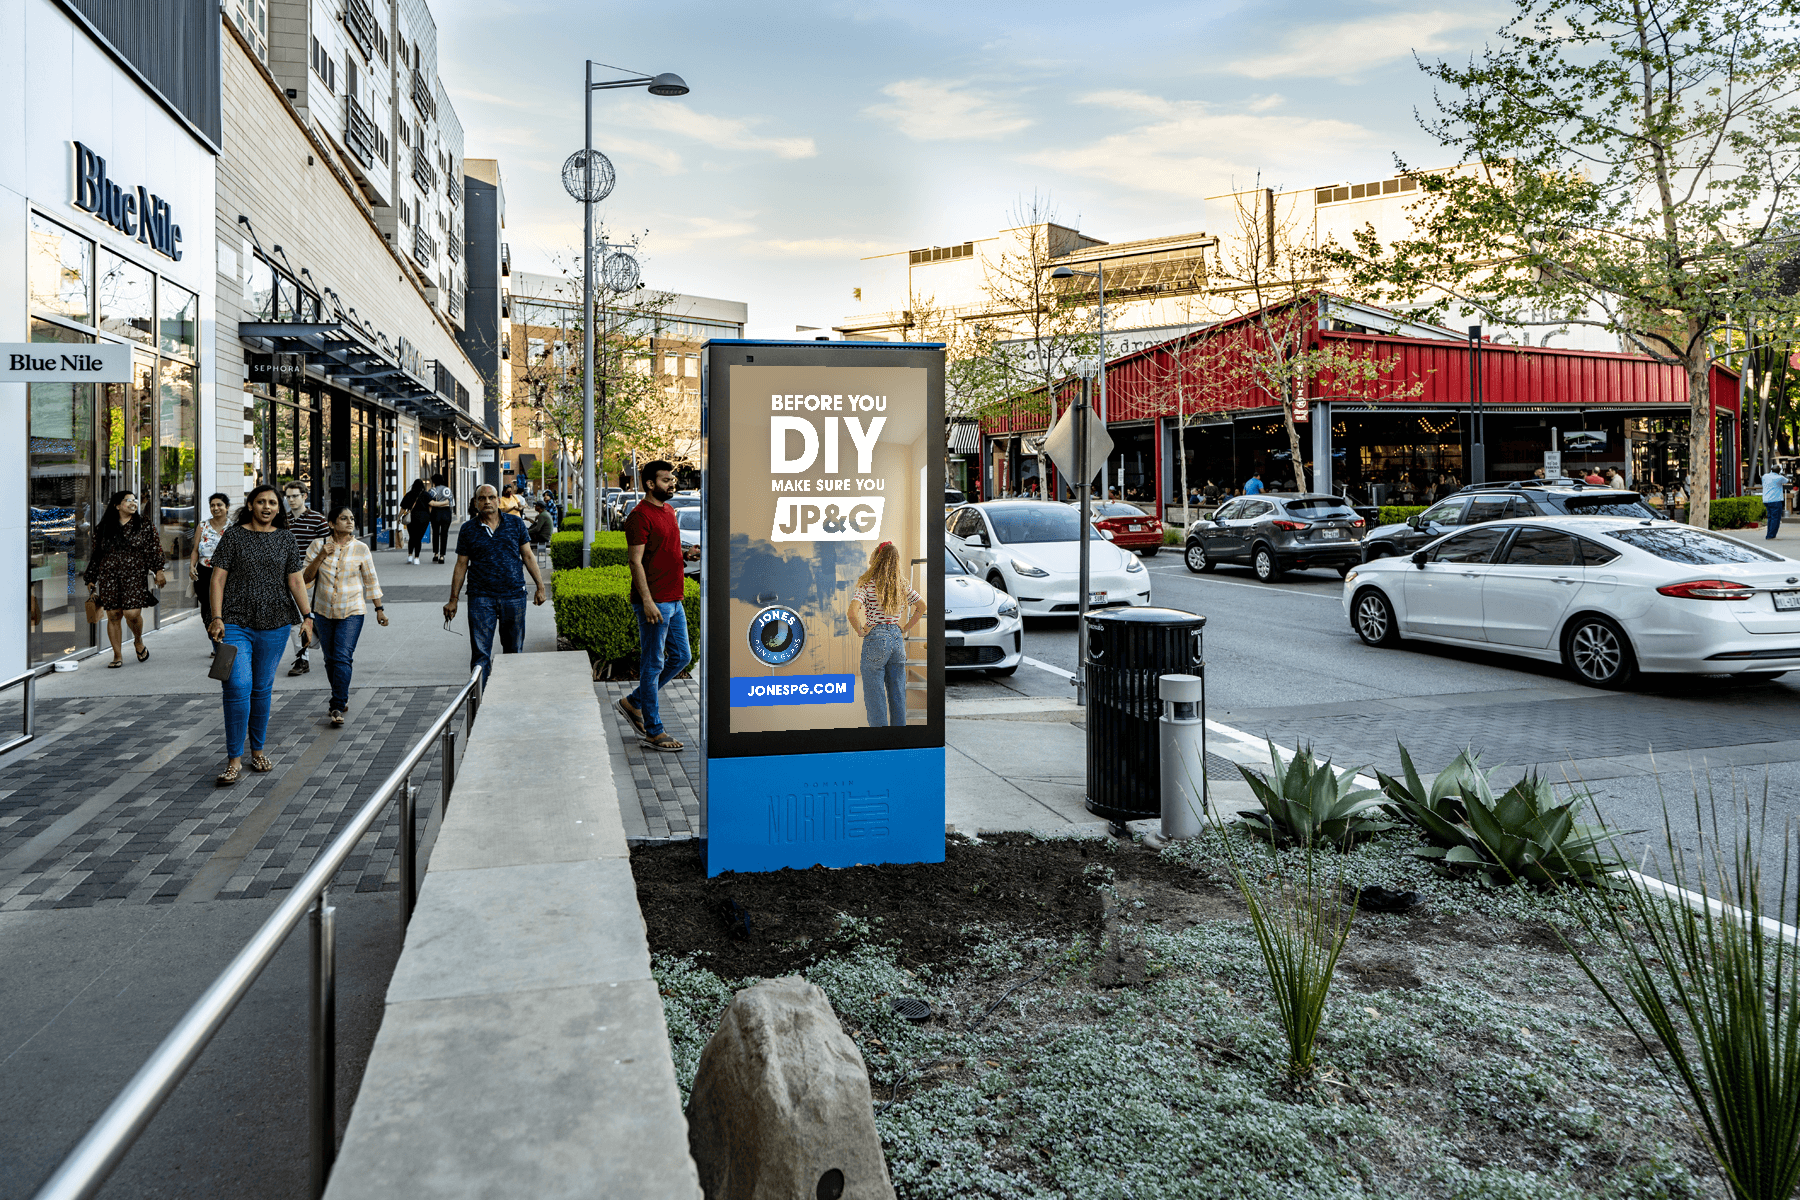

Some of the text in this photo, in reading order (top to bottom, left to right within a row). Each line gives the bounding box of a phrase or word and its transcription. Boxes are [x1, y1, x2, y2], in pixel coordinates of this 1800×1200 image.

[72, 140, 183, 262] Blue Nile
[9, 354, 103, 371] Blue Nile
[254, 364, 300, 372] SEPHORA
[771, 394, 887, 412] BEFORE YOU
[770, 415, 888, 474] DIY
[771, 478, 885, 492] MAKE SURE YOU
[778, 503, 877, 535] JP&G
[758, 610, 796, 627] JONES
[747, 682, 847, 697] JONESPG.COM
[803, 780, 854, 788] DOMAIN
